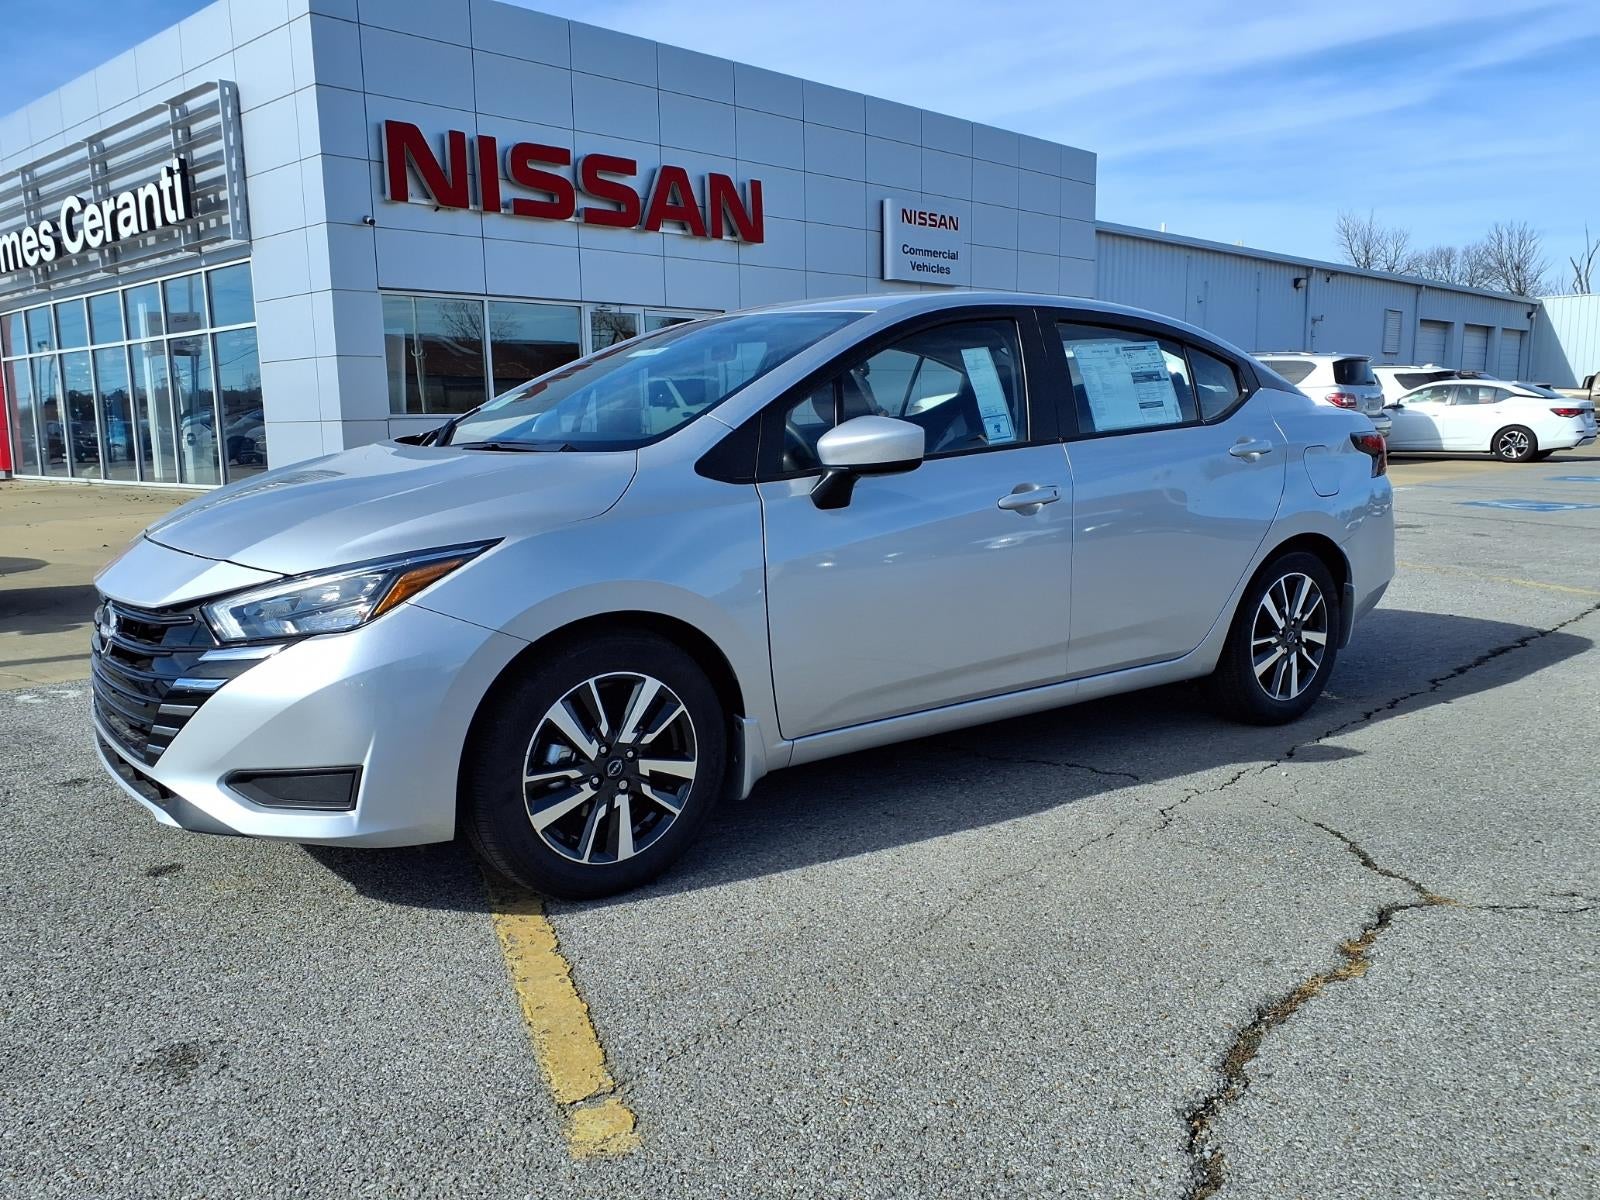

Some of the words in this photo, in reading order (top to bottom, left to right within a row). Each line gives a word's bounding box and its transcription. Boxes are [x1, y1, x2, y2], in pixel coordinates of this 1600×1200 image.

[384, 120, 764, 244] NISSAN
[61, 158, 187, 254] Ceranti
[901, 208, 959, 231] NISSAN
[902, 244, 959, 260] Commercial
[910, 261, 951, 275] Vehicles
